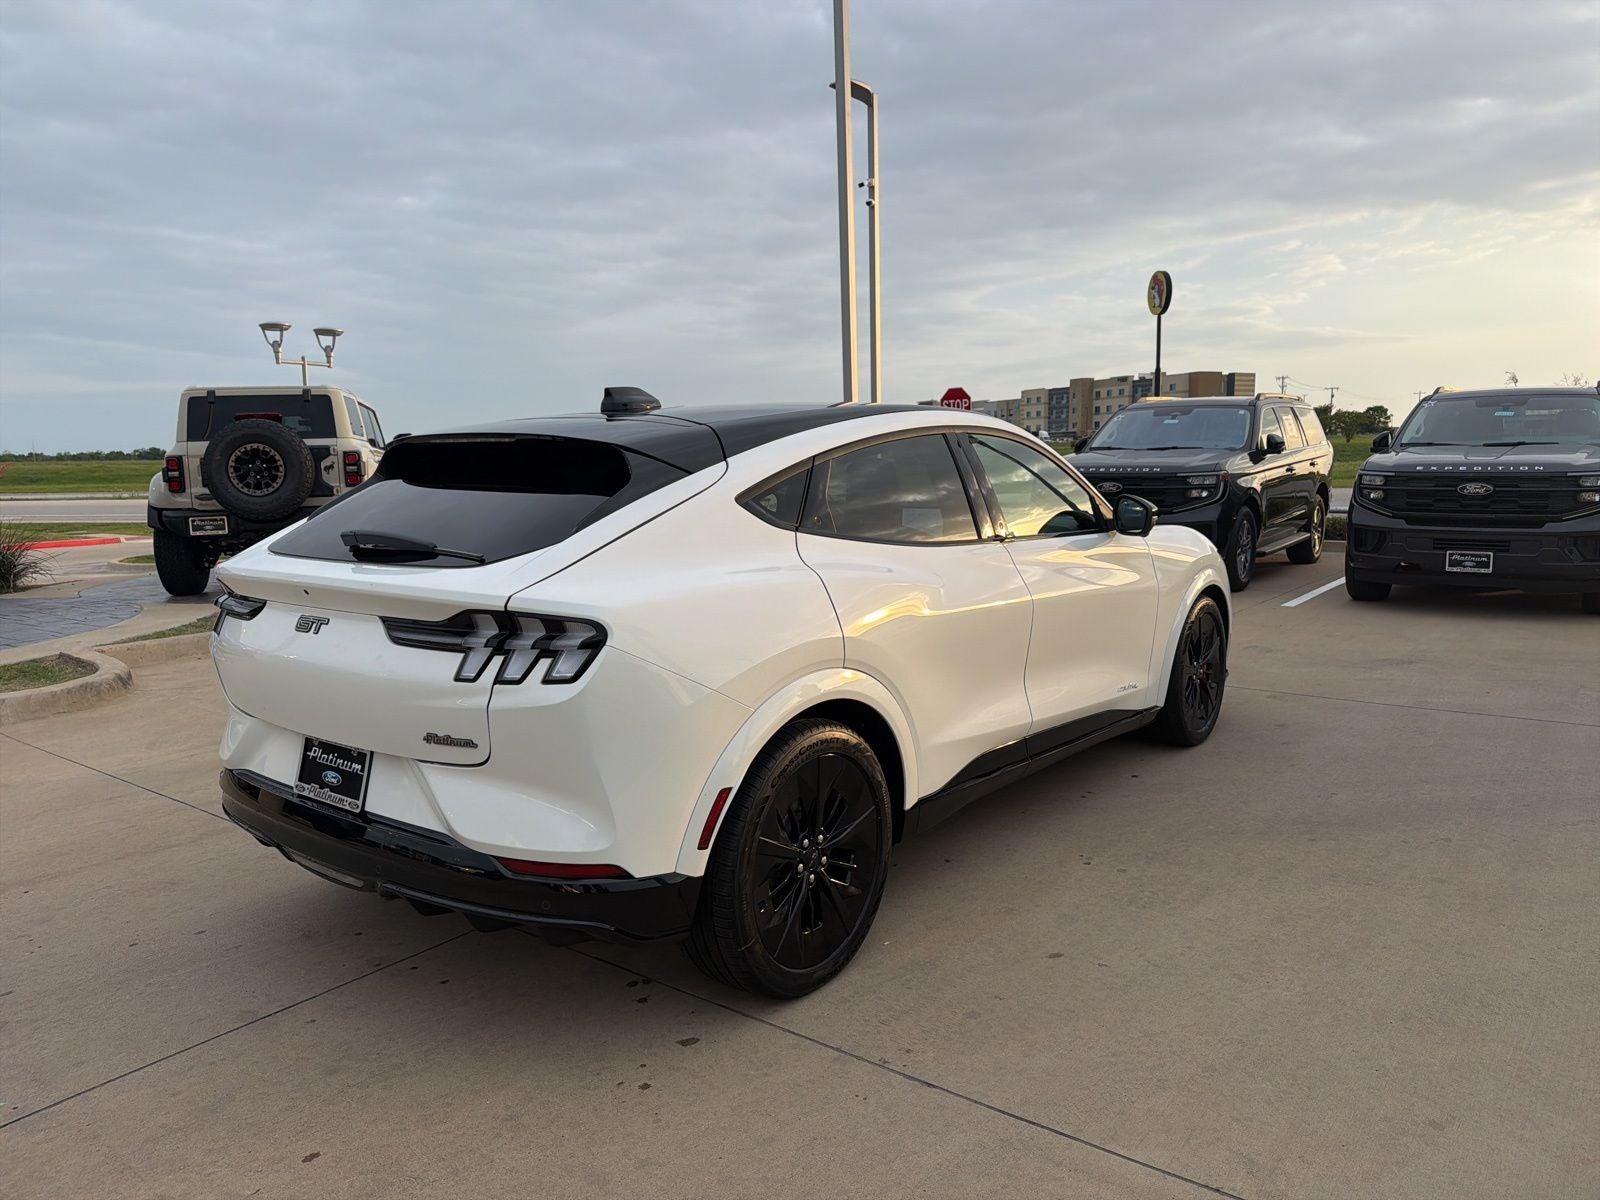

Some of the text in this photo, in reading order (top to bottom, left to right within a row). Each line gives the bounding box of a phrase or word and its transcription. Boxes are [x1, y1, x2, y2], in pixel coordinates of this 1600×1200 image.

[943, 399, 969, 410] STOP
[295, 615, 330, 635] GT
[423, 733, 478, 749] Platinum
[306, 747, 364, 776] Platinum
[307, 784, 348, 807] Platinum
